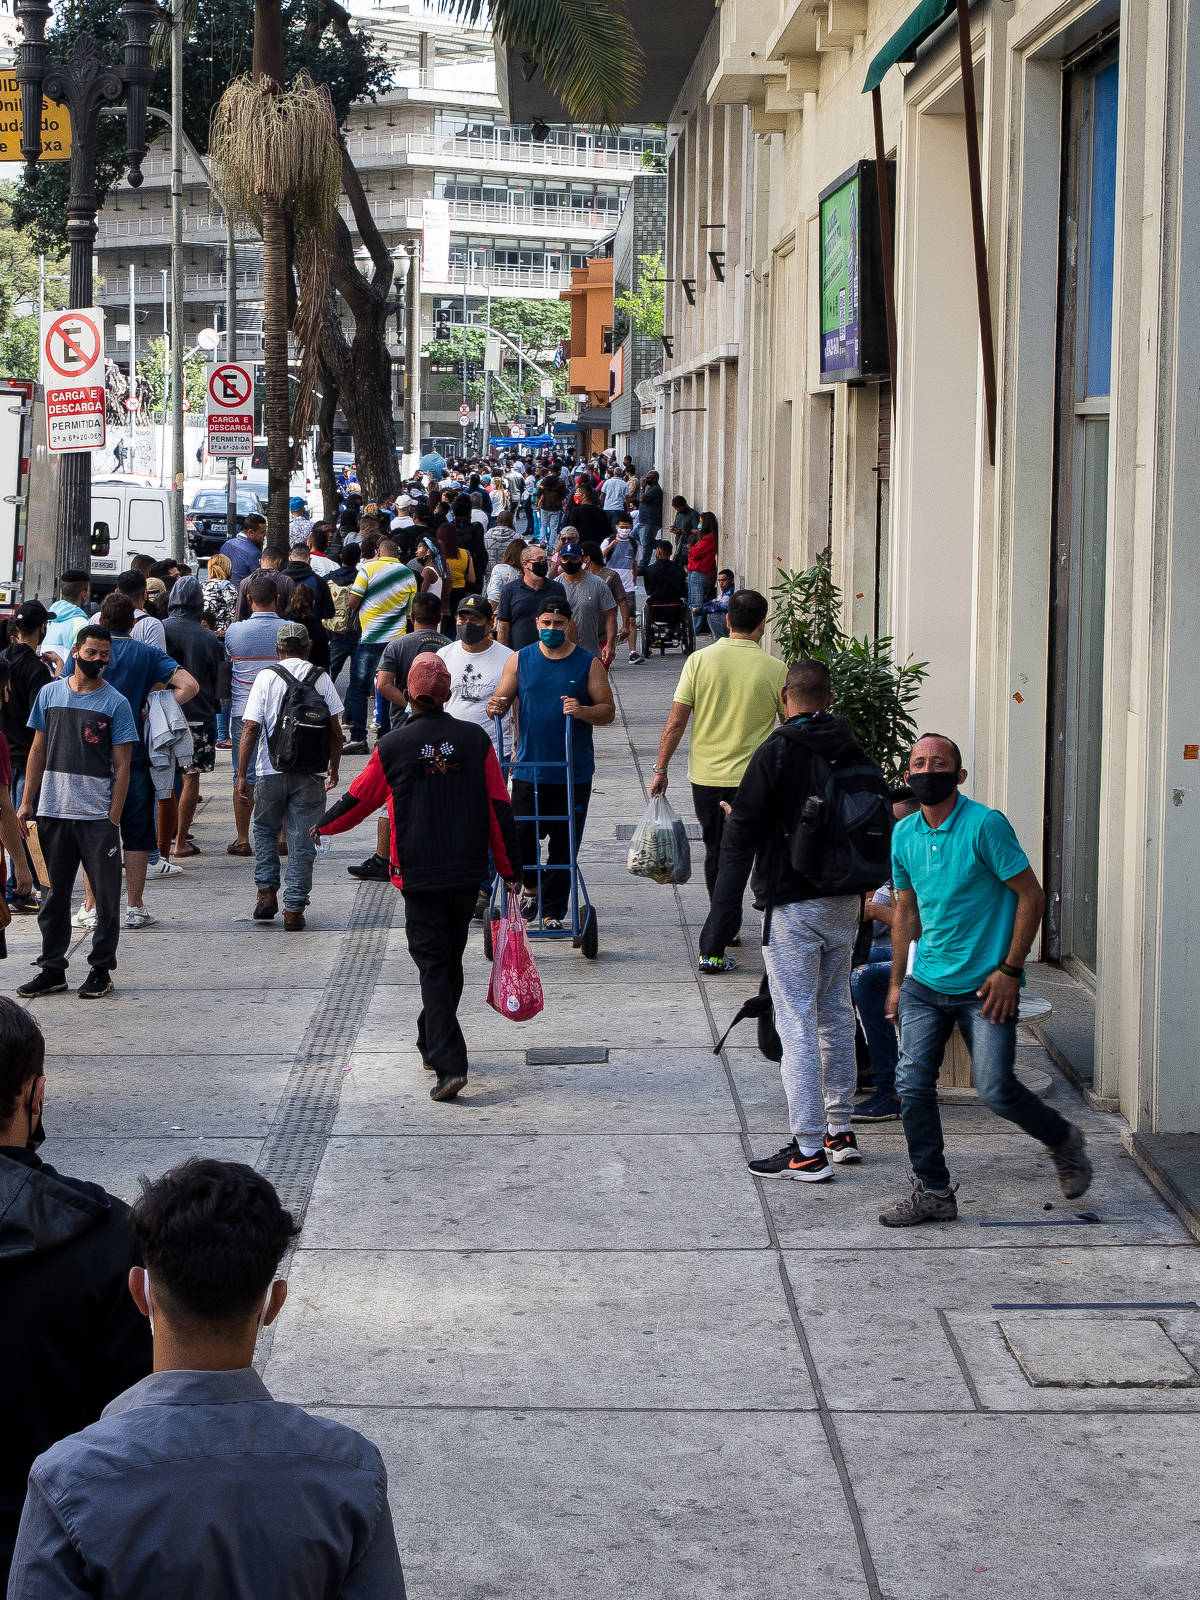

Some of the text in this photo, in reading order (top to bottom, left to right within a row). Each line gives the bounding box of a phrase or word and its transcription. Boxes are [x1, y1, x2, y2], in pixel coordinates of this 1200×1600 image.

[51, 389, 98, 402] CARGA E
[48, 401, 103, 415] DESCARGA
[52, 419, 101, 431] PERMITIDA
[210, 435, 251, 443] PERMITIDA
